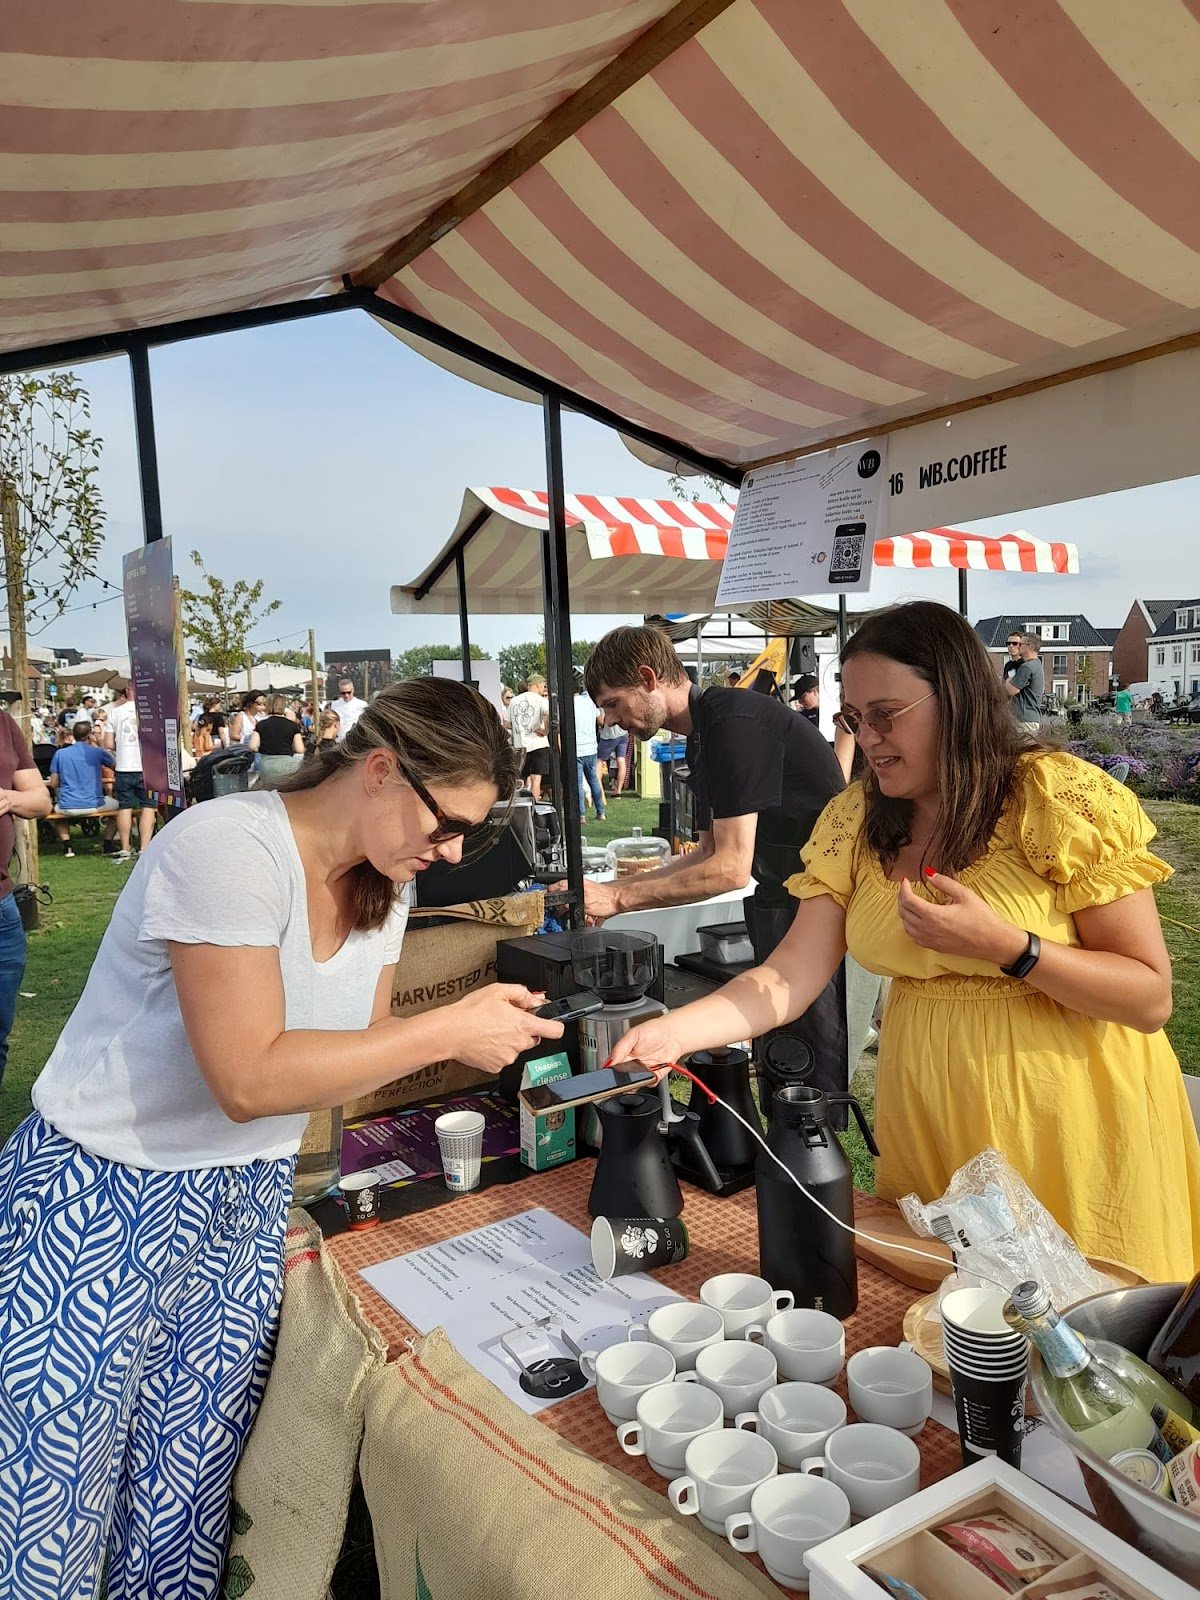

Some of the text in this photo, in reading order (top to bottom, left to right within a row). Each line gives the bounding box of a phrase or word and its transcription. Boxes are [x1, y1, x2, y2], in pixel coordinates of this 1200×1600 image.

[888, 444, 1008, 496] 16 WB.COFFEE
[390, 968, 480, 1008] HARVESTED
[373, 1075, 443, 1101] PERFECTION
[536, 1072, 568, 1086] cleanse
[366, 1210, 375, 1218] GO
[663, 1227, 672, 1251] TO GO
[1176, 1484, 1190, 1508] SUGAR
